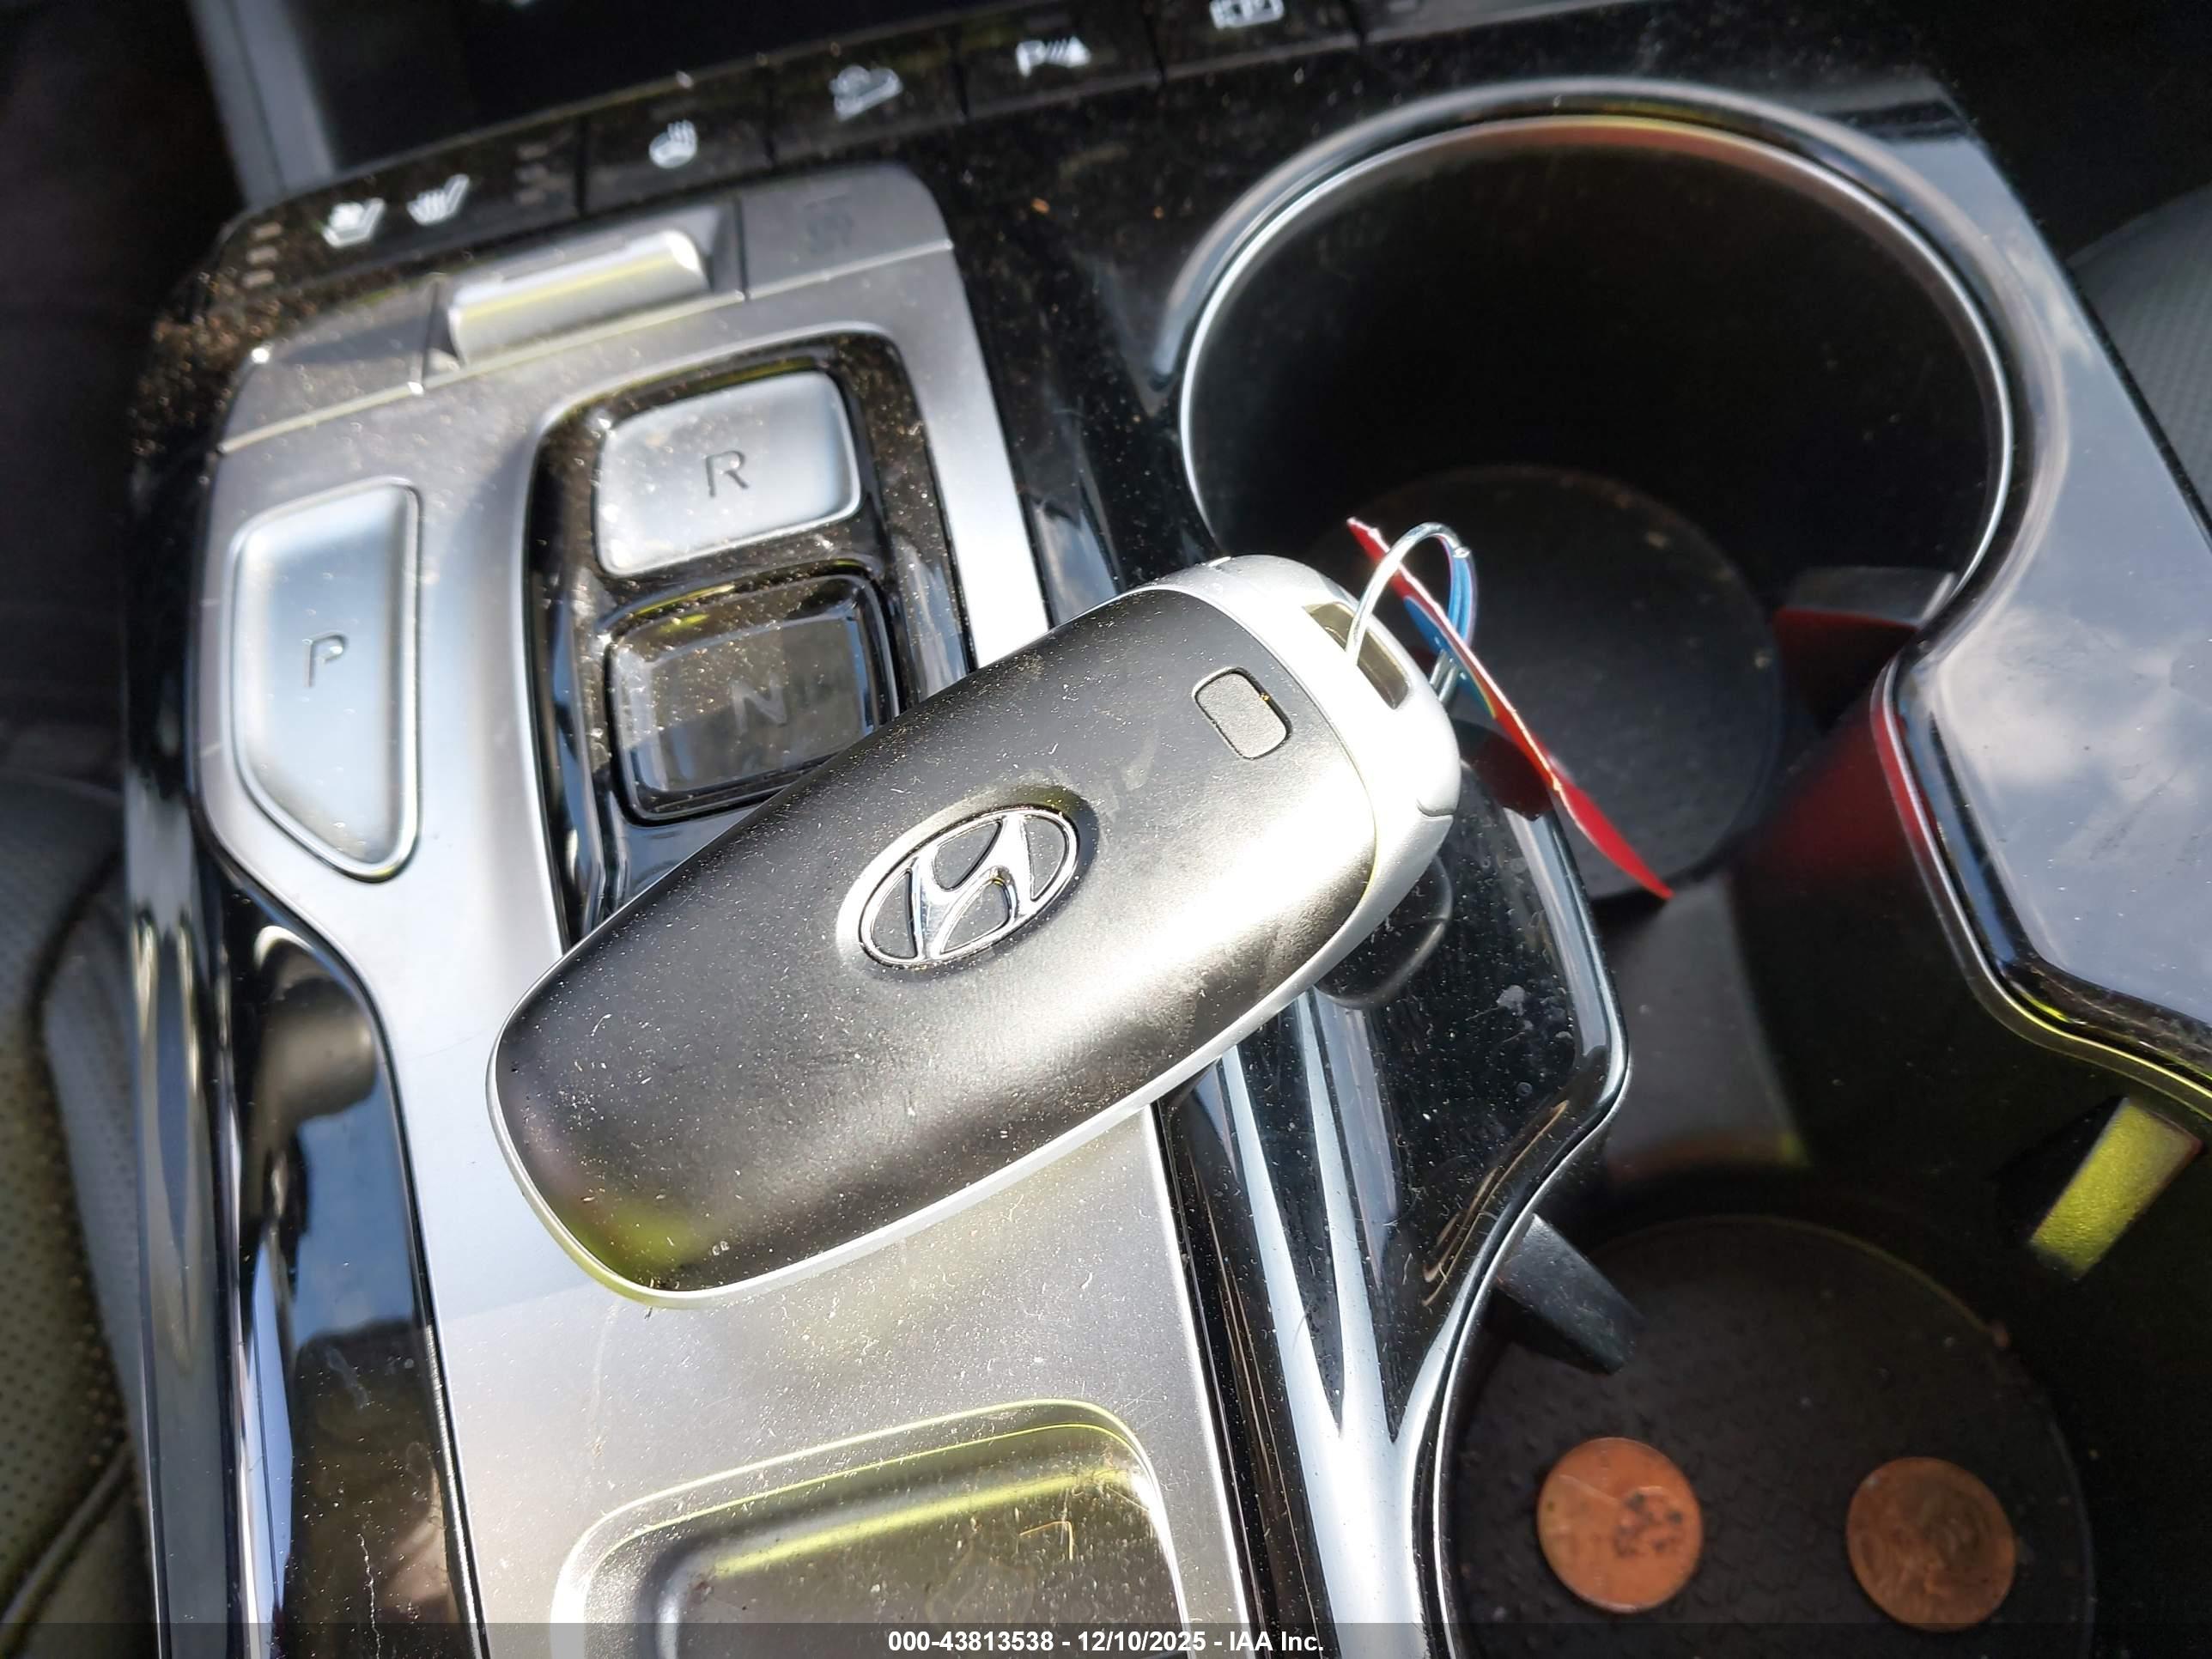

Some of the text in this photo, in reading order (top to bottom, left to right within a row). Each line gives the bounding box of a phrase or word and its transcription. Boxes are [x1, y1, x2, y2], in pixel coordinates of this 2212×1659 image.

[705, 450, 749, 498] R
[302, 631, 349, 689] P
[731, 673, 787, 736] N
